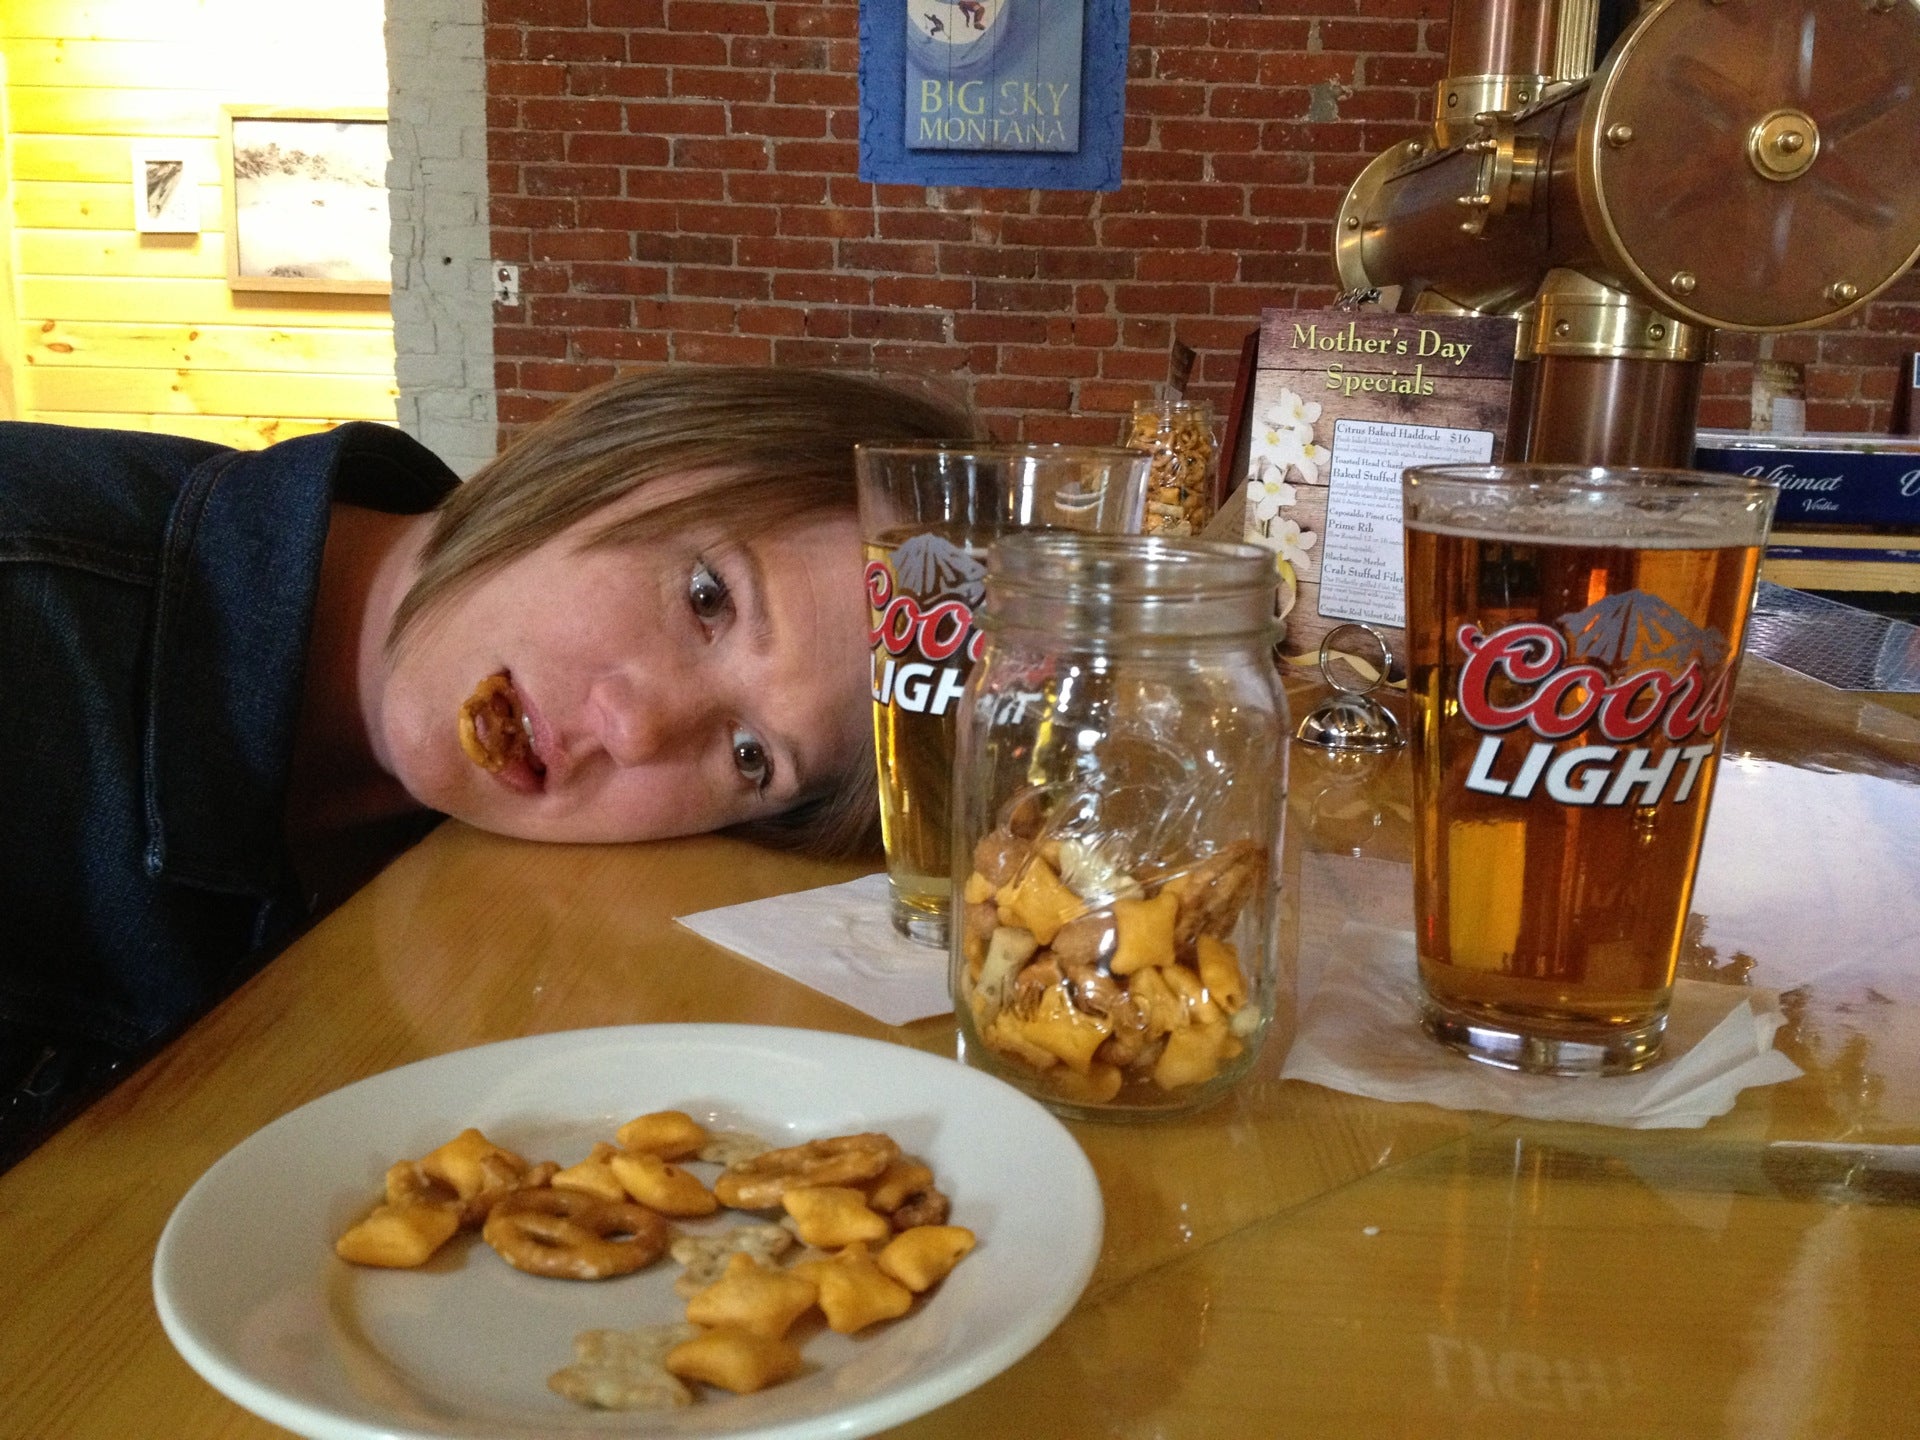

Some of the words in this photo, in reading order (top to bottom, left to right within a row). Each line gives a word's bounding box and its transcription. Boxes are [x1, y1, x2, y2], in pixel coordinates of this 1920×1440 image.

[920, 79, 985, 115] BIG
[1000, 81, 1069, 117] SKY
[919, 117, 1066, 144] MONTANA
[1290, 322, 1409, 356] Mother's
[1415, 329, 1473, 366] Day
[1325, 363, 1435, 397] Specials
[1336, 424, 1366, 436] Citrus
[1368, 425, 1397, 438] Baked
[1398, 428, 1441, 442] Haddock
[1449, 433, 1471, 444] $16
[1333, 467, 1361, 479] Baked
[1363, 470, 1397, 483] Stuffed
[1802, 497, 1840, 512] Vodka
[1328, 519, 1355, 531] Prime
[1358, 522, 1374, 533] Rib
[1323, 563, 1346, 576] Crab
[1347, 566, 1381, 580] Stuffed
[1383, 571, 1404, 584] Filet
[1458, 622, 1735, 741] Coors
[1465, 734, 1714, 806] LIGHT
